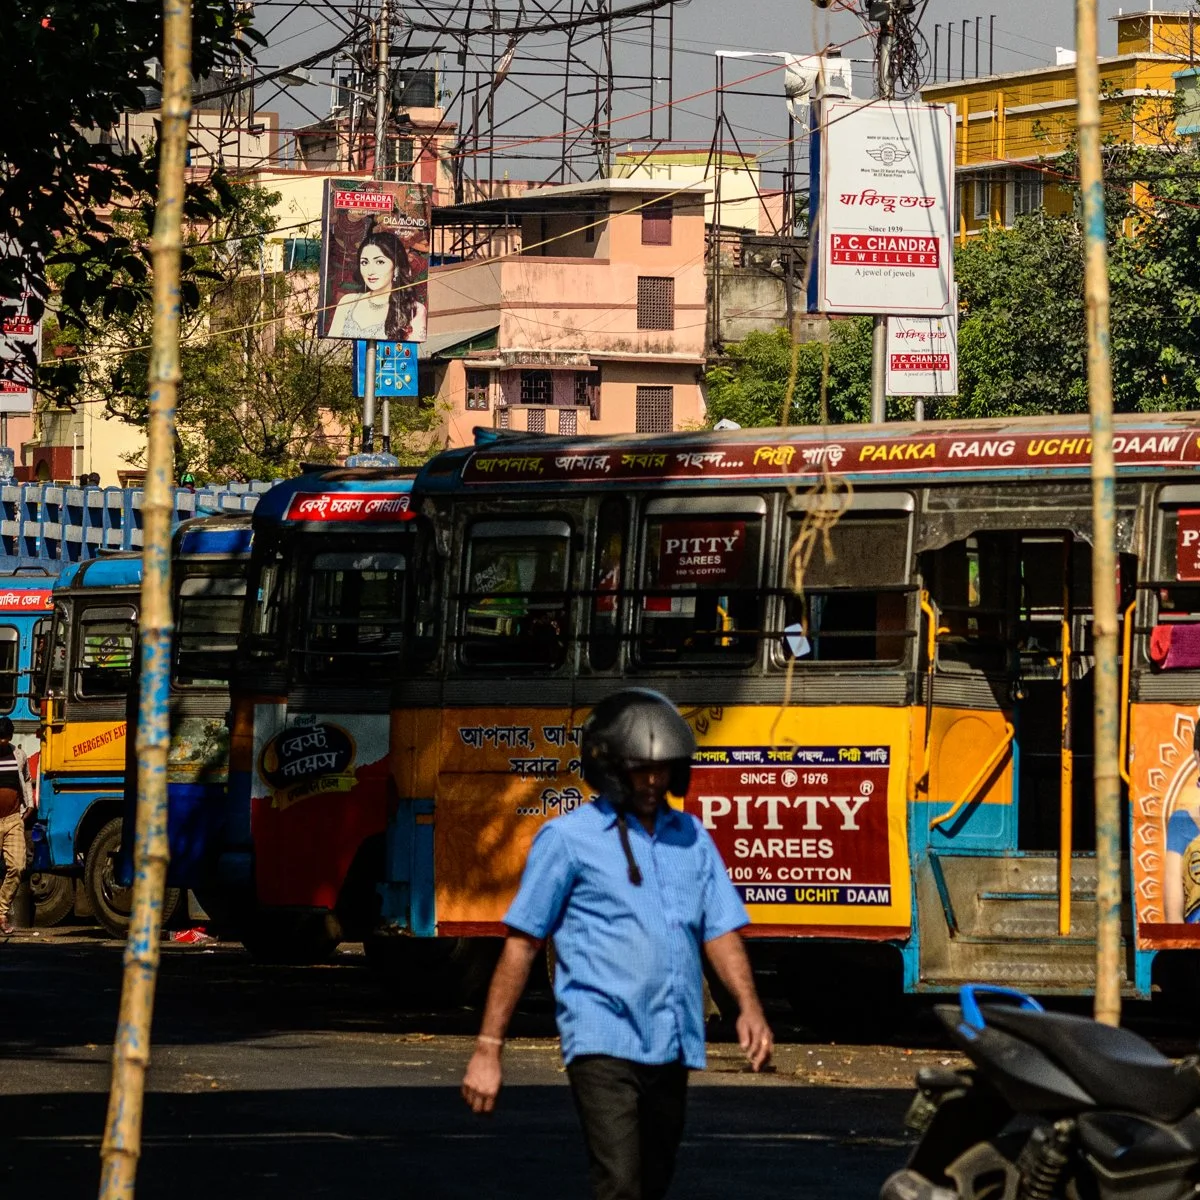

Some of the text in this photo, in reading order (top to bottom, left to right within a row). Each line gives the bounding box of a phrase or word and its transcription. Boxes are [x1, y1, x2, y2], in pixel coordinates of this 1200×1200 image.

[354, 194, 392, 202] CHANDRA
[839, 188, 936, 213] যা কিছু শুভ
[868, 225, 886, 233] Since
[833, 236, 937, 252] P. C. CHANDRA
[833, 252, 937, 264] JEWELLERS
[854, 268, 916, 279] A jewel of jewels
[859, 443, 937, 462] PAKKA
[947, 440, 1016, 459] RANG
[1110, 435, 1180, 454] DAAM
[474, 456, 545, 474] আপনার,
[554, 455, 612, 473] আমার,
[620, 453, 668, 470] সবার
[801, 445, 846, 468] শাড়ি
[665, 535, 738, 554] PITTY
[678, 555, 722, 566] SAREES
[696, 567, 727, 575] COTTON
[72, 730, 113, 758] EMERGENCY
[460, 726, 534, 750] আপনার,
[732, 750, 765, 763] আমার,
[767, 750, 794, 762] সবার
[864, 748, 888, 764] শাড়ি
[740, 772, 829, 785] SINCE 1976
[697, 795, 871, 831] PITTY
[733, 838, 835, 859] SAREES
[757, 867, 773, 881] %
[777, 867, 852, 881] COTTON
[745, 887, 890, 904] RANG UCHIT DAAM
